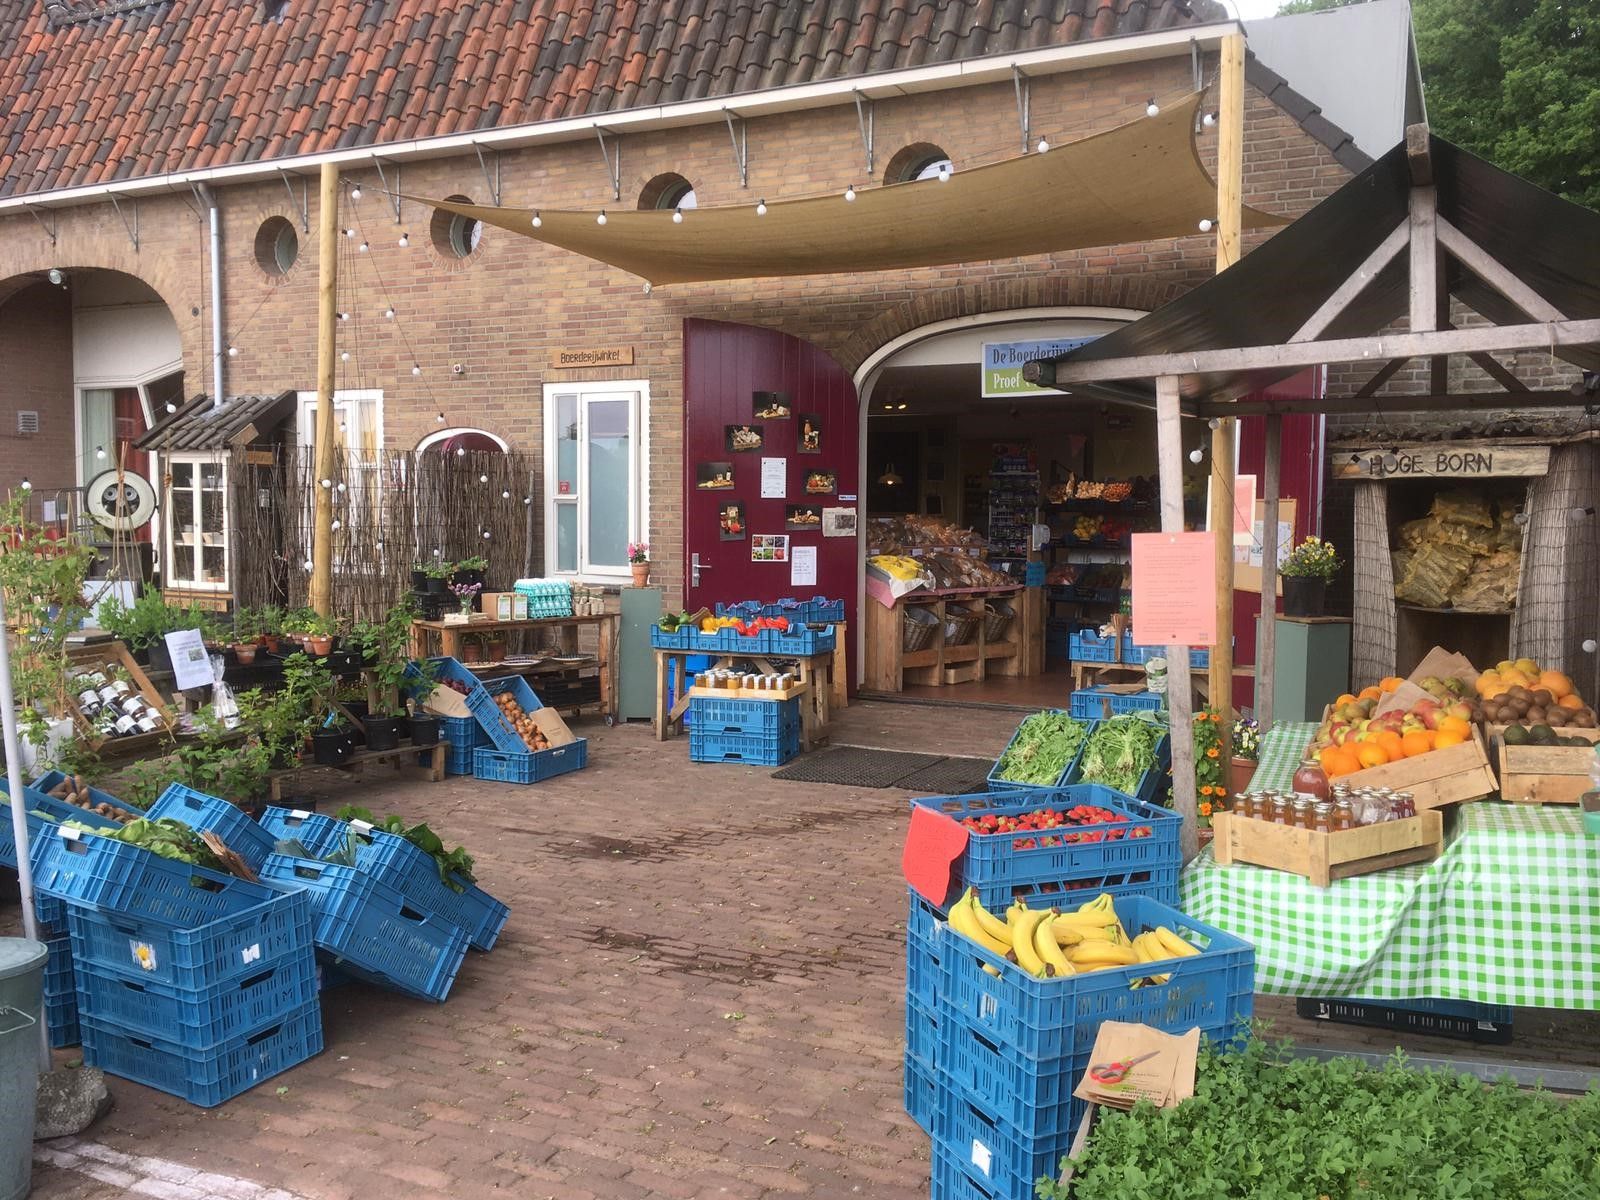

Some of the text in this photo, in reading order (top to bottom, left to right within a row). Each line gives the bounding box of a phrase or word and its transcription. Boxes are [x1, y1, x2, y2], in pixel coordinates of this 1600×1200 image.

[993, 343, 1083, 364] De Boerderij
[993, 371, 1021, 389] Proef
[1369, 453, 1493, 475] HOGE BORN
